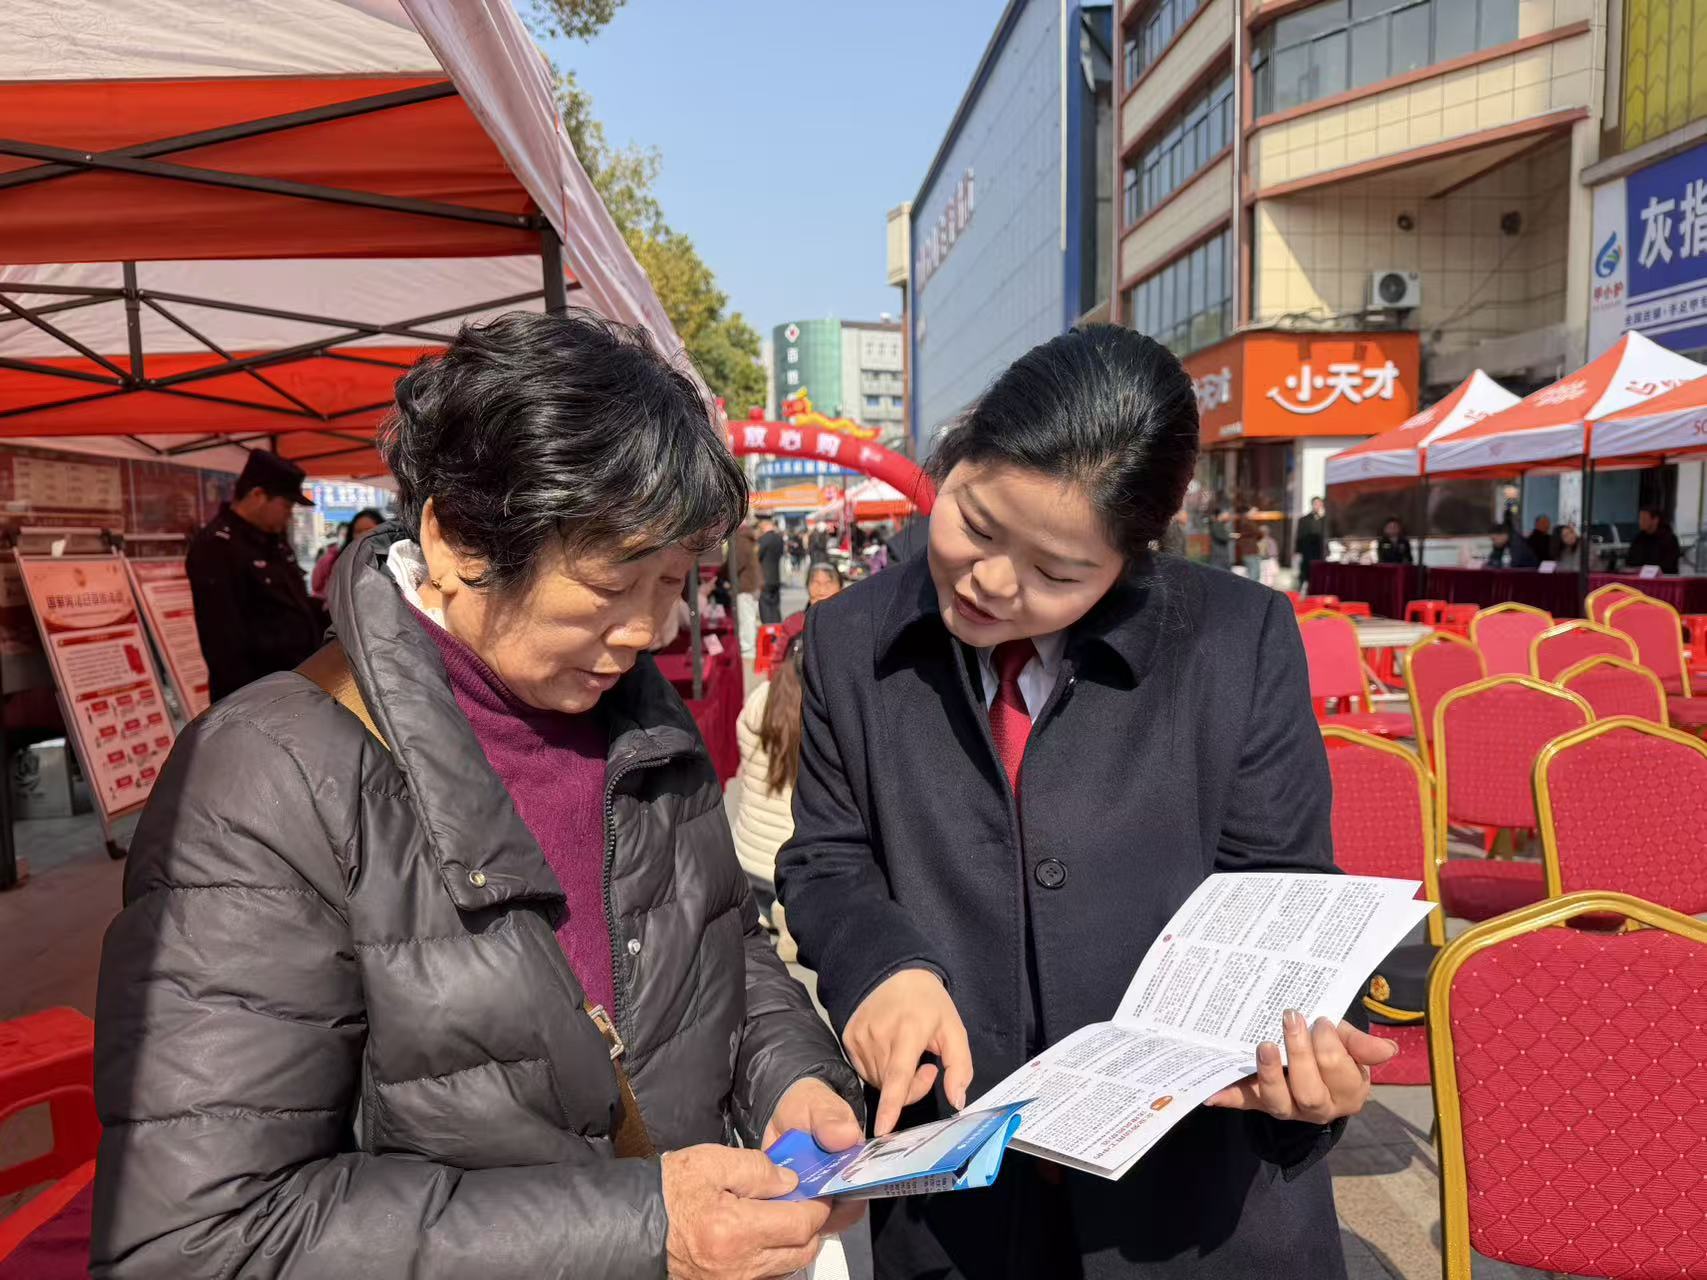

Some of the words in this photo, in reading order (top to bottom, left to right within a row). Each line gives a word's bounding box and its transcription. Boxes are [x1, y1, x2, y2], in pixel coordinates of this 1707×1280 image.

[1638, 178, 1707, 269] 灰指
[1266, 360, 1400, 414] 小天才
